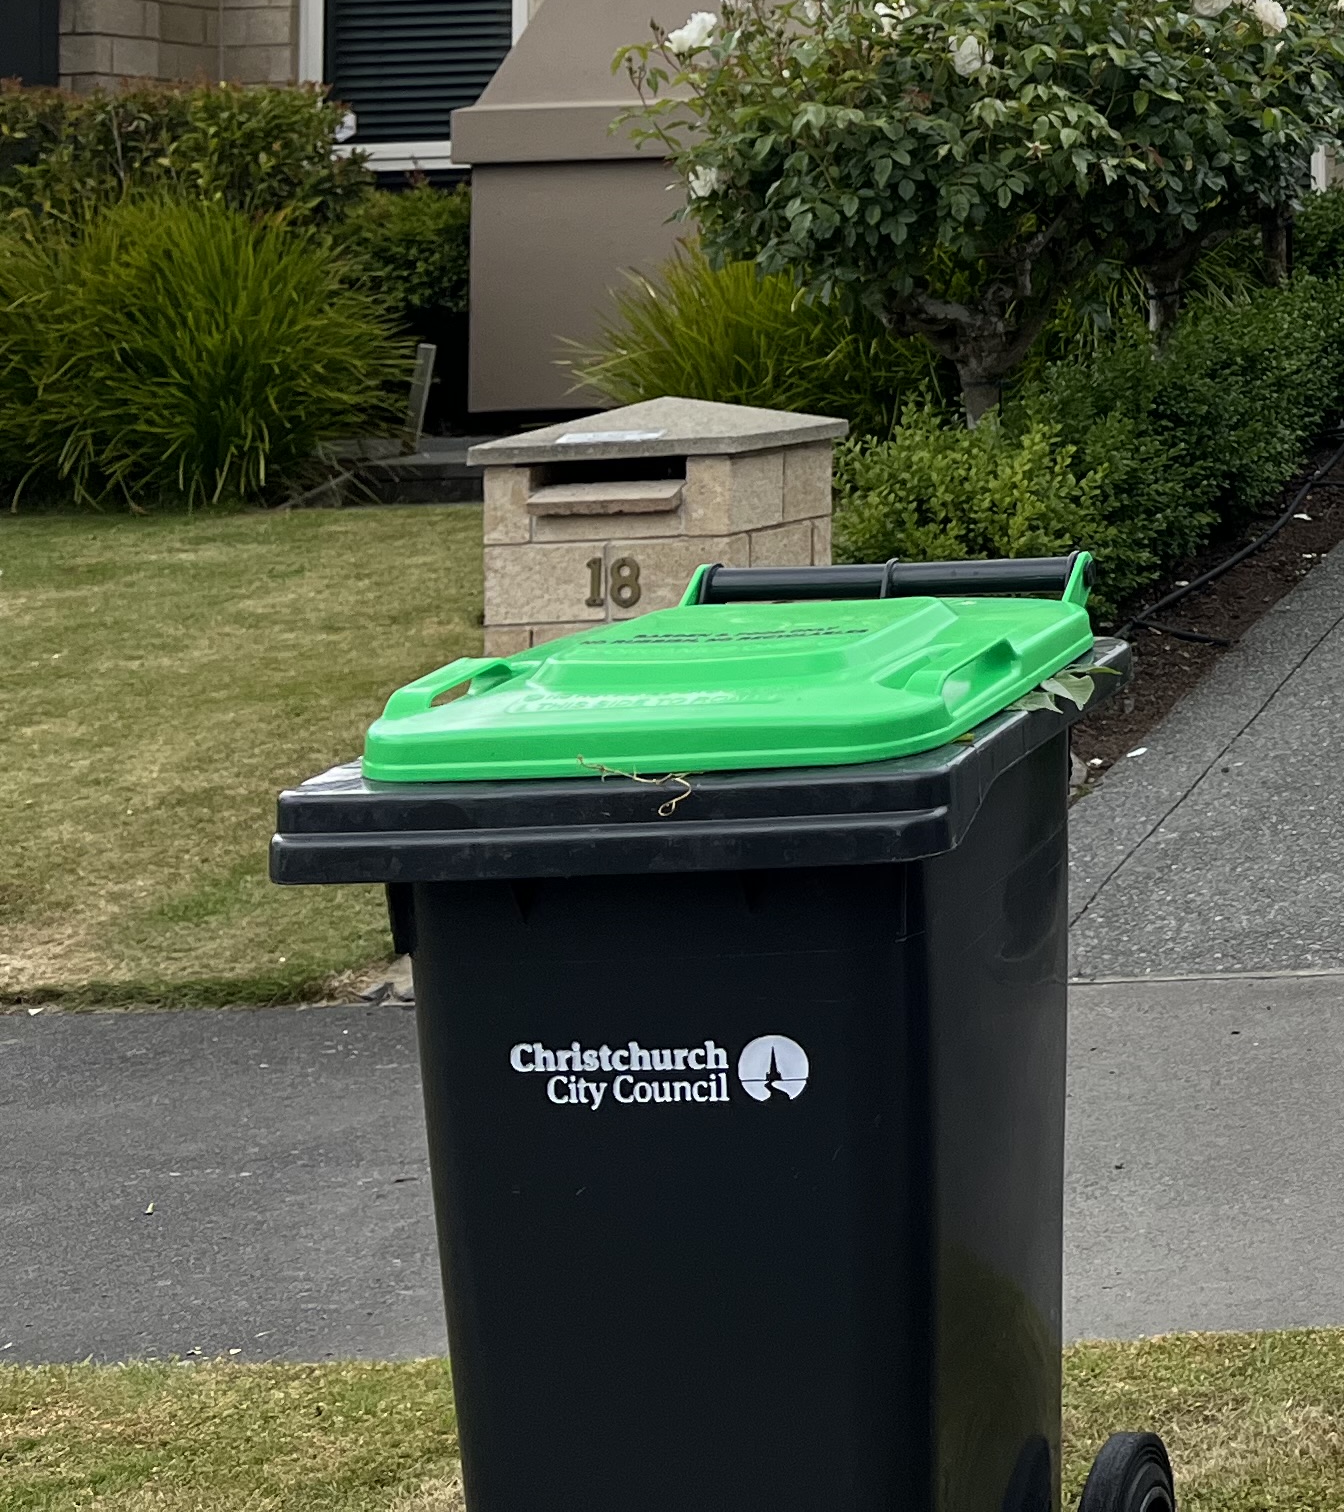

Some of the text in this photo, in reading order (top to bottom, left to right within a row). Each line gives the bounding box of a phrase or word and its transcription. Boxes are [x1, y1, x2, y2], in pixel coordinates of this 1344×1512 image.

[584, 557, 642, 609] 18
[509, 1040, 730, 1072] Christchurch
[546, 1073, 731, 1111] City Council
